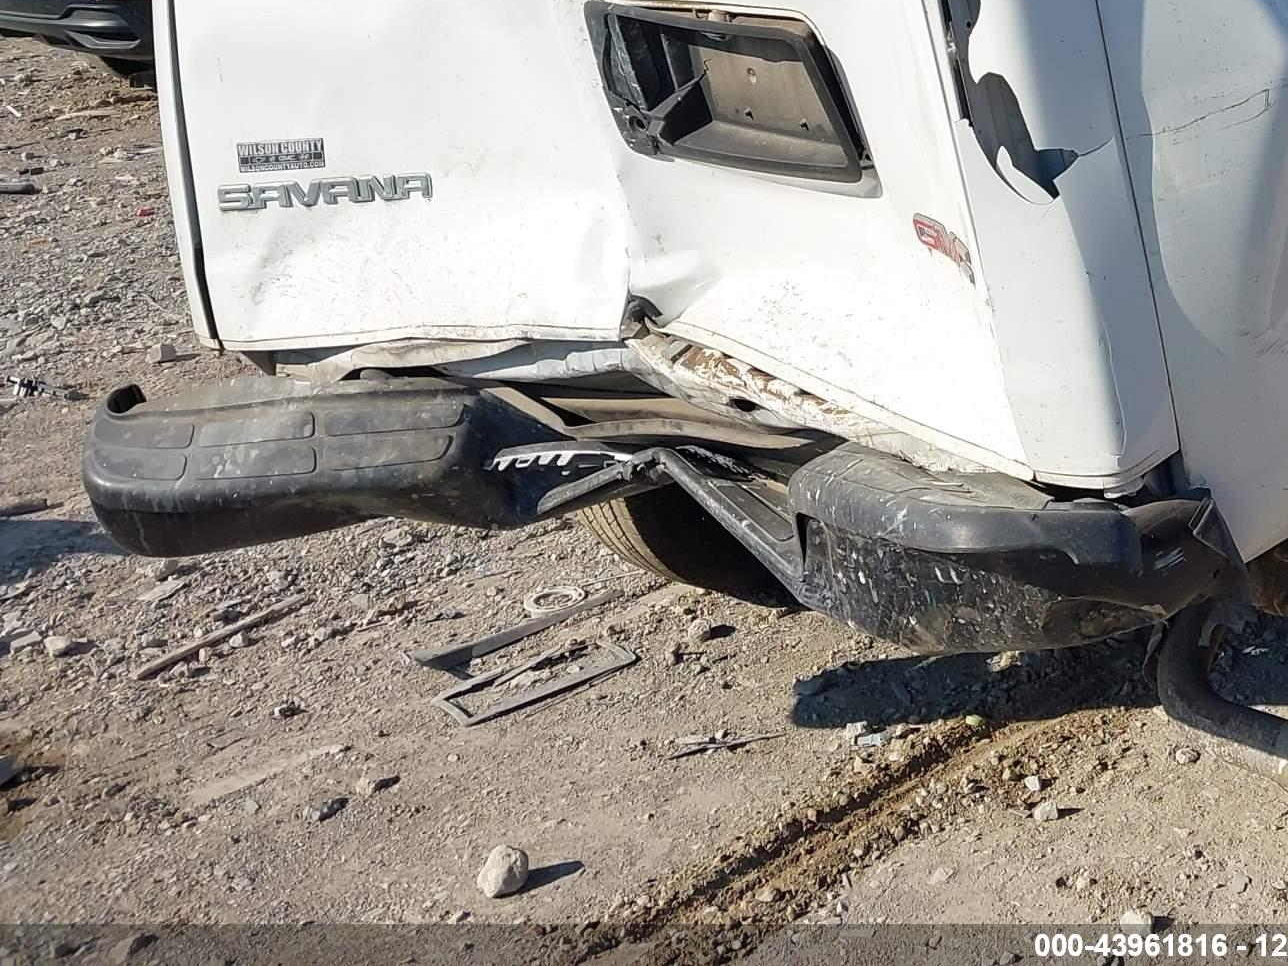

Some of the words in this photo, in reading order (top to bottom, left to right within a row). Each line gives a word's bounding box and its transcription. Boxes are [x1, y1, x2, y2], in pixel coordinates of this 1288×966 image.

[238, 143, 279, 156] WILSON
[280, 140, 322, 154] COUNTY
[216, 172, 433, 211] SAVANA
